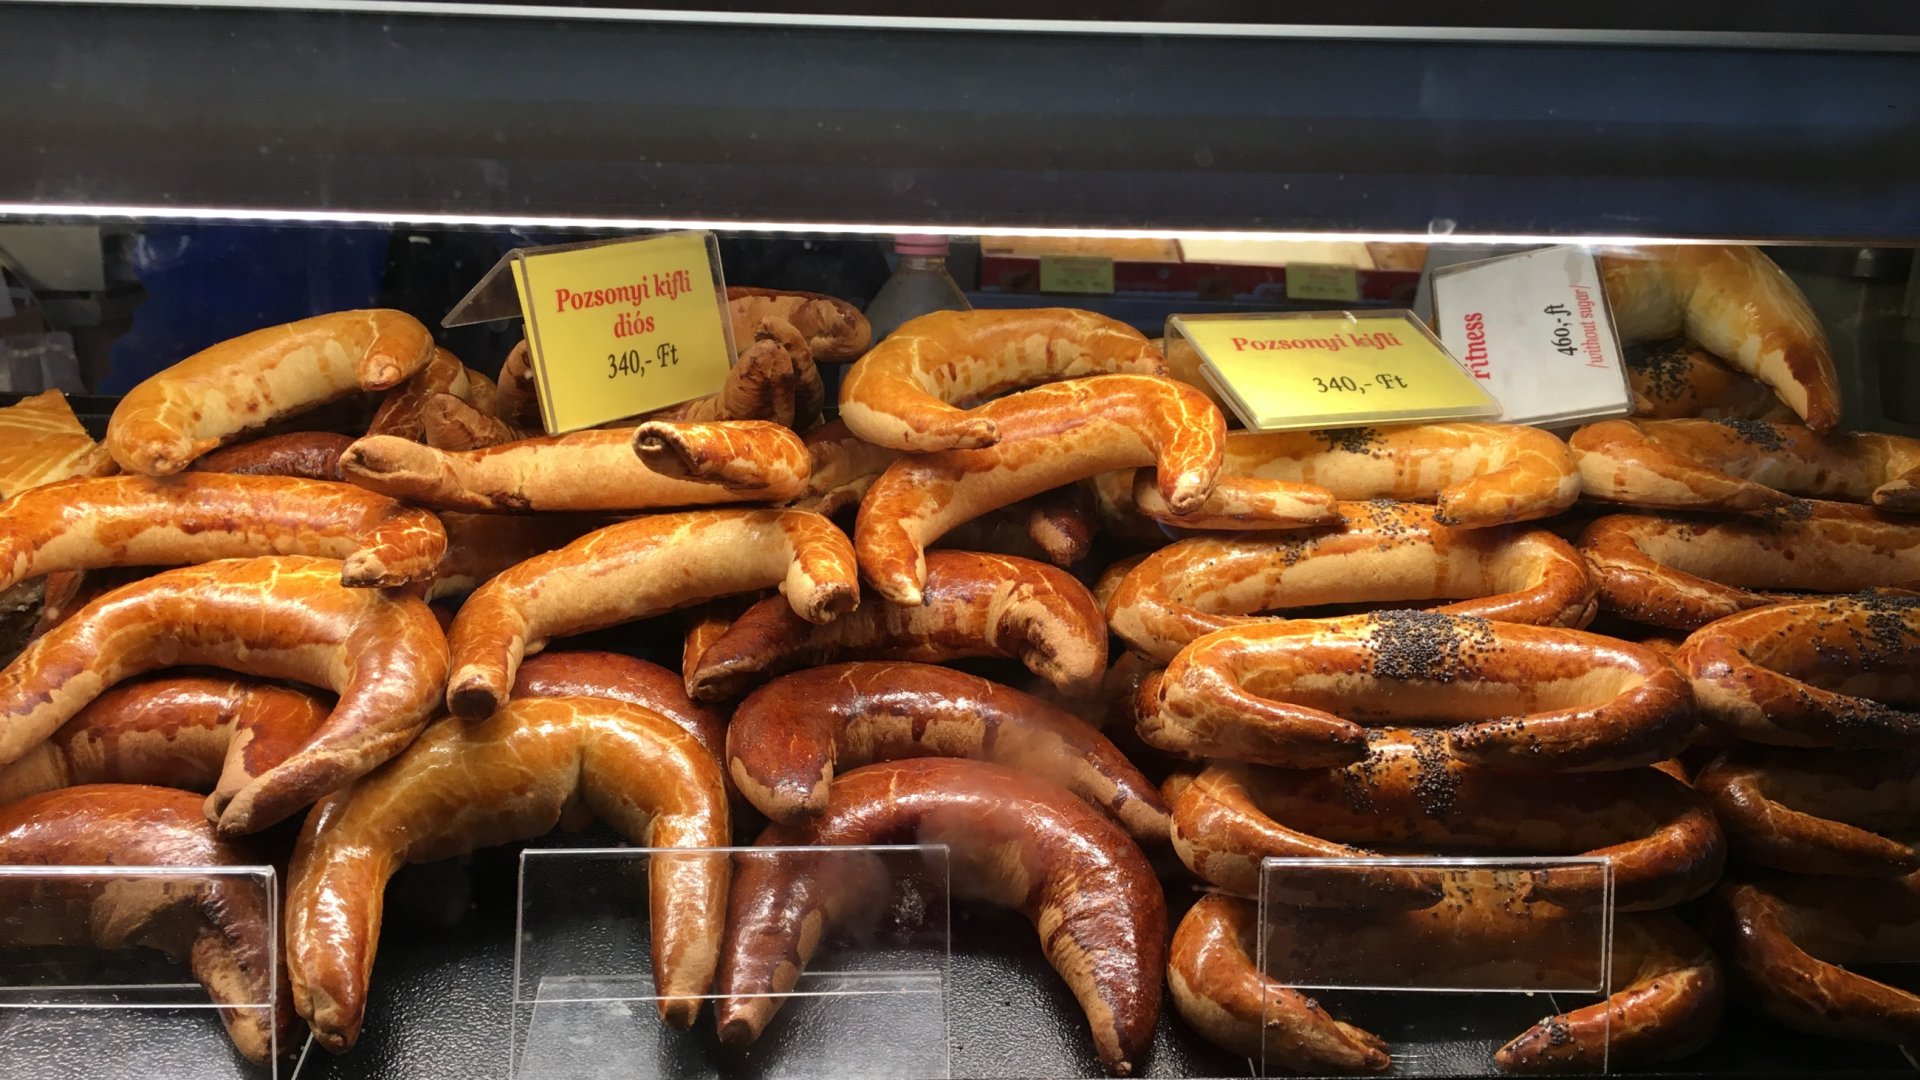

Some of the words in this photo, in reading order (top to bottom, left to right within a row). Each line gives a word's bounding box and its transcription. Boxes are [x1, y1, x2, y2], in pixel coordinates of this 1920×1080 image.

[556, 277, 649, 312] Pozsonyi
[653, 270, 692, 300] kifli
[1544, 303, 1572, 316] ft
[613, 312, 655, 338] diós
[1231, 334, 1342, 352] Pozsonyi
[1350, 332, 1403, 350] kifli
[607, 350, 652, 379] 340,-
[657, 343, 679, 367] Ft
[1312, 375, 1372, 394] 340,-
[1376, 373, 1408, 390] Ft
